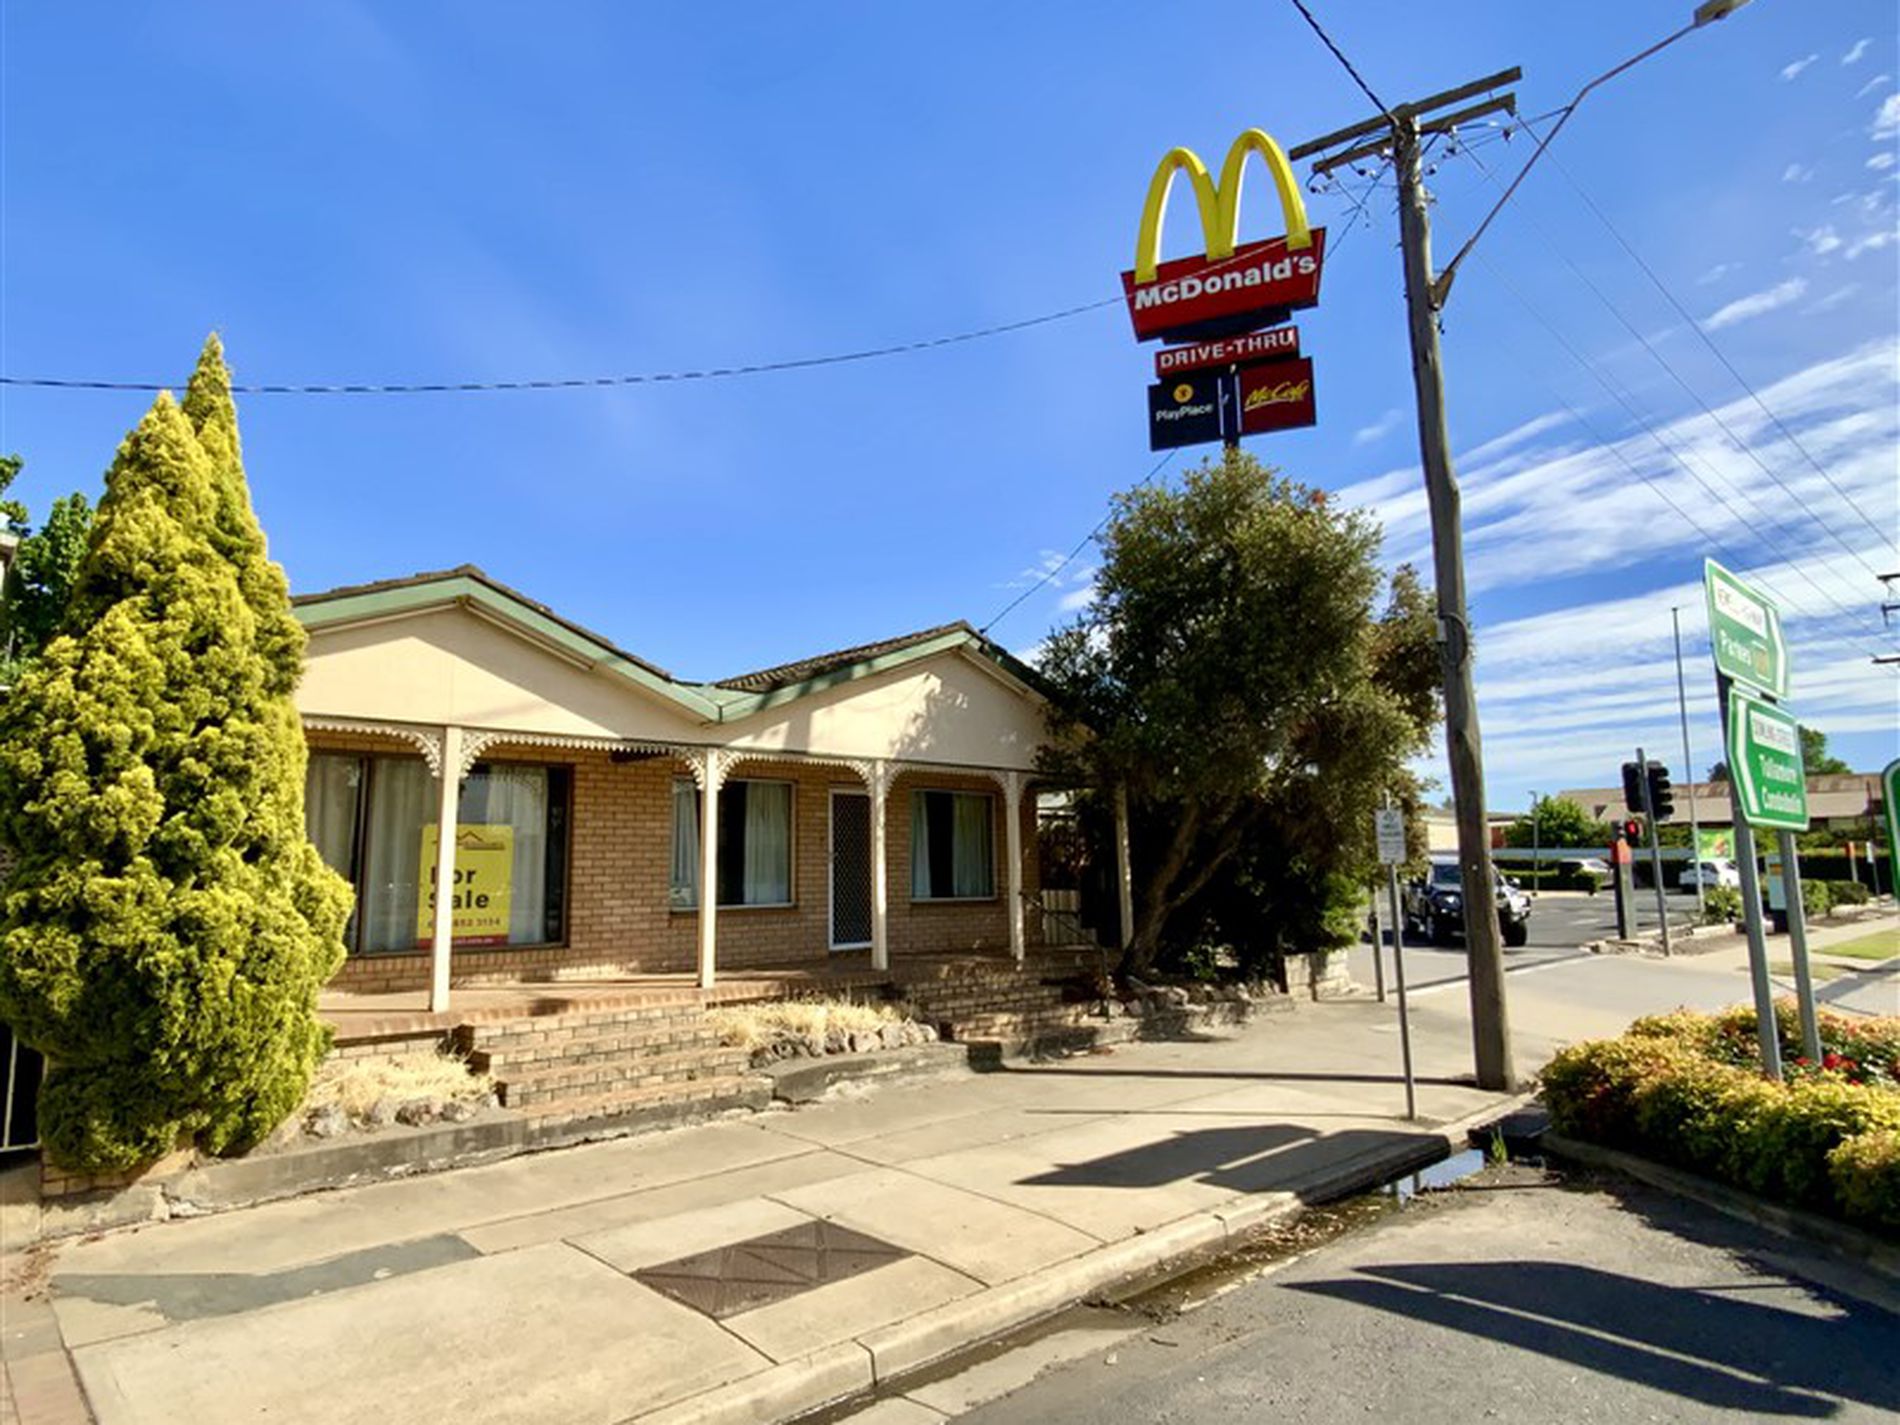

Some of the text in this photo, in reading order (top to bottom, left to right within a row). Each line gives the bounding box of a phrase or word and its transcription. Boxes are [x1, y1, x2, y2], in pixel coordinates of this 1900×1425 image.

[1134, 255, 1317, 310] McDonald's
[1160, 330, 1296, 368] DRIVE-THRU
[1156, 404, 1214, 422] PlayPlace
